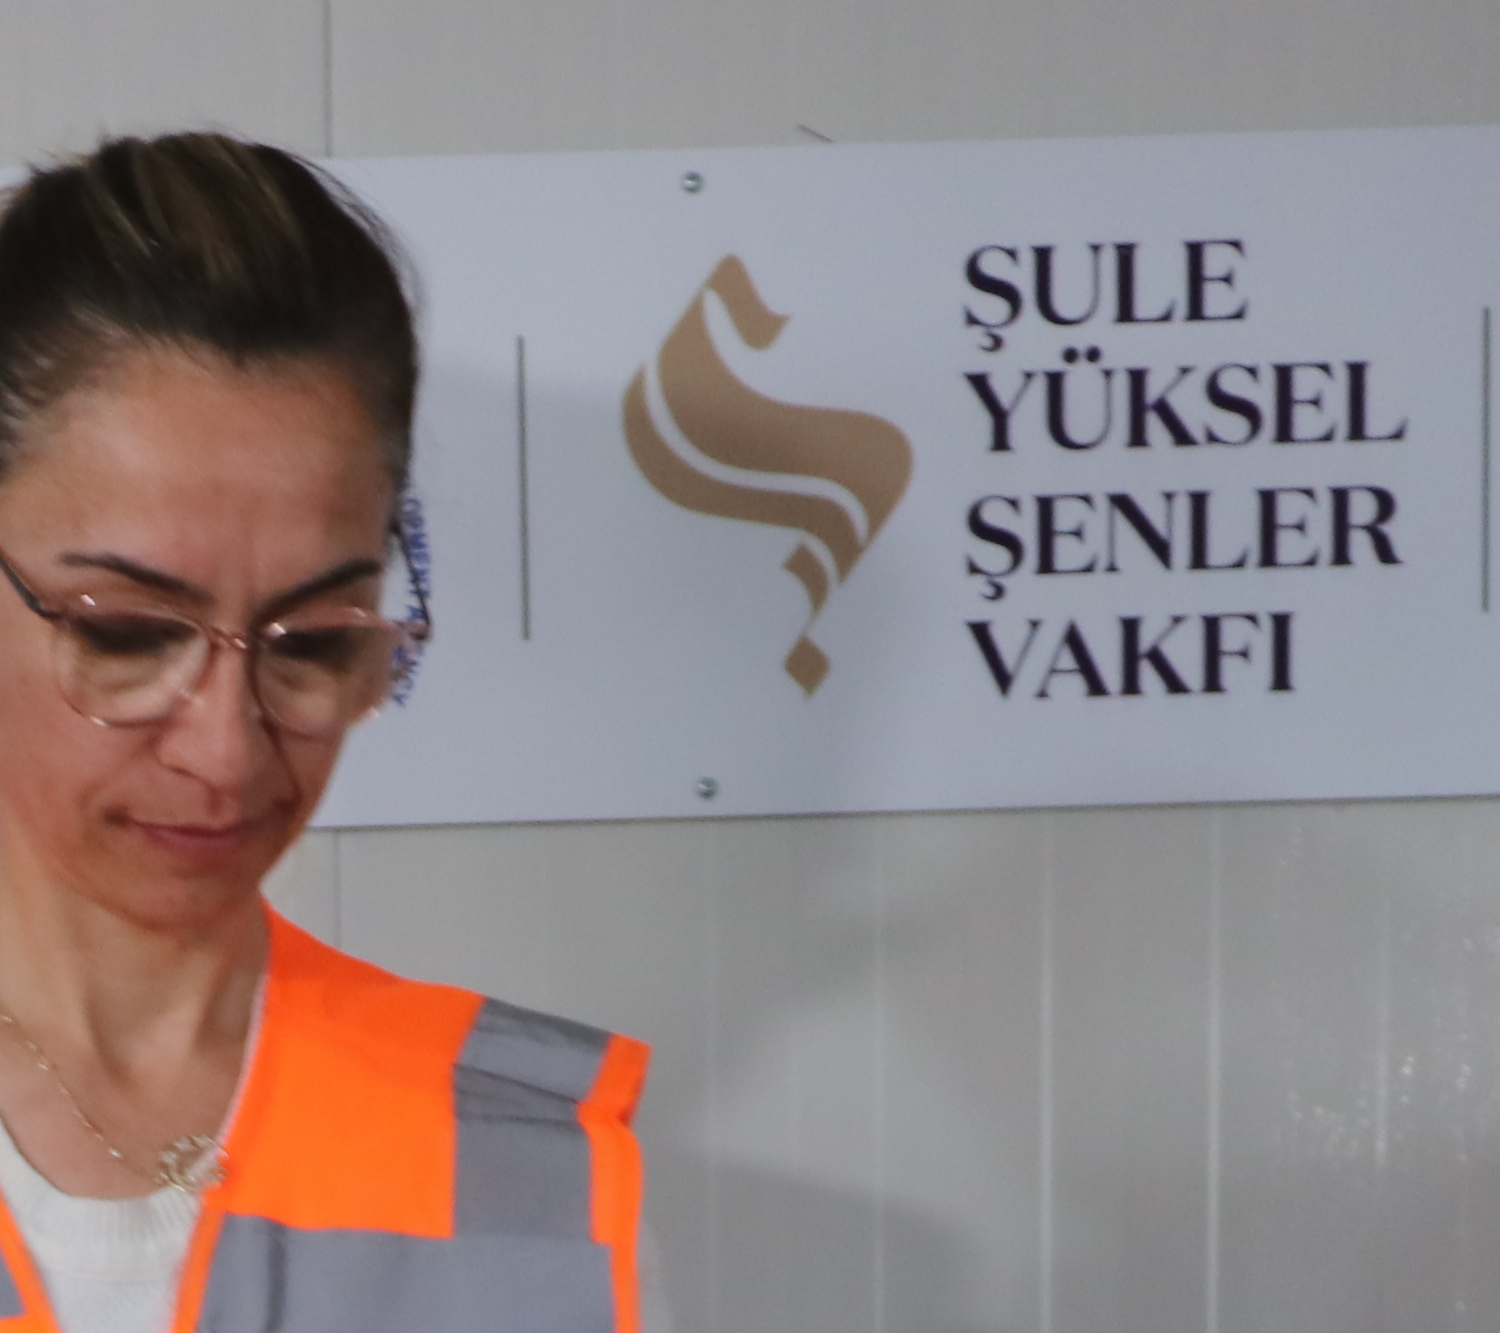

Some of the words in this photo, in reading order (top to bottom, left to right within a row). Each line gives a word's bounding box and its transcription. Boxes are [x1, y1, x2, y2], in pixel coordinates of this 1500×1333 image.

[962, 239, 1248, 352] ŞULE
[963, 345, 1408, 452] YÜKSEL
[966, 485, 1404, 600] ŞENLER
[964, 611, 1295, 699] VAKFI
